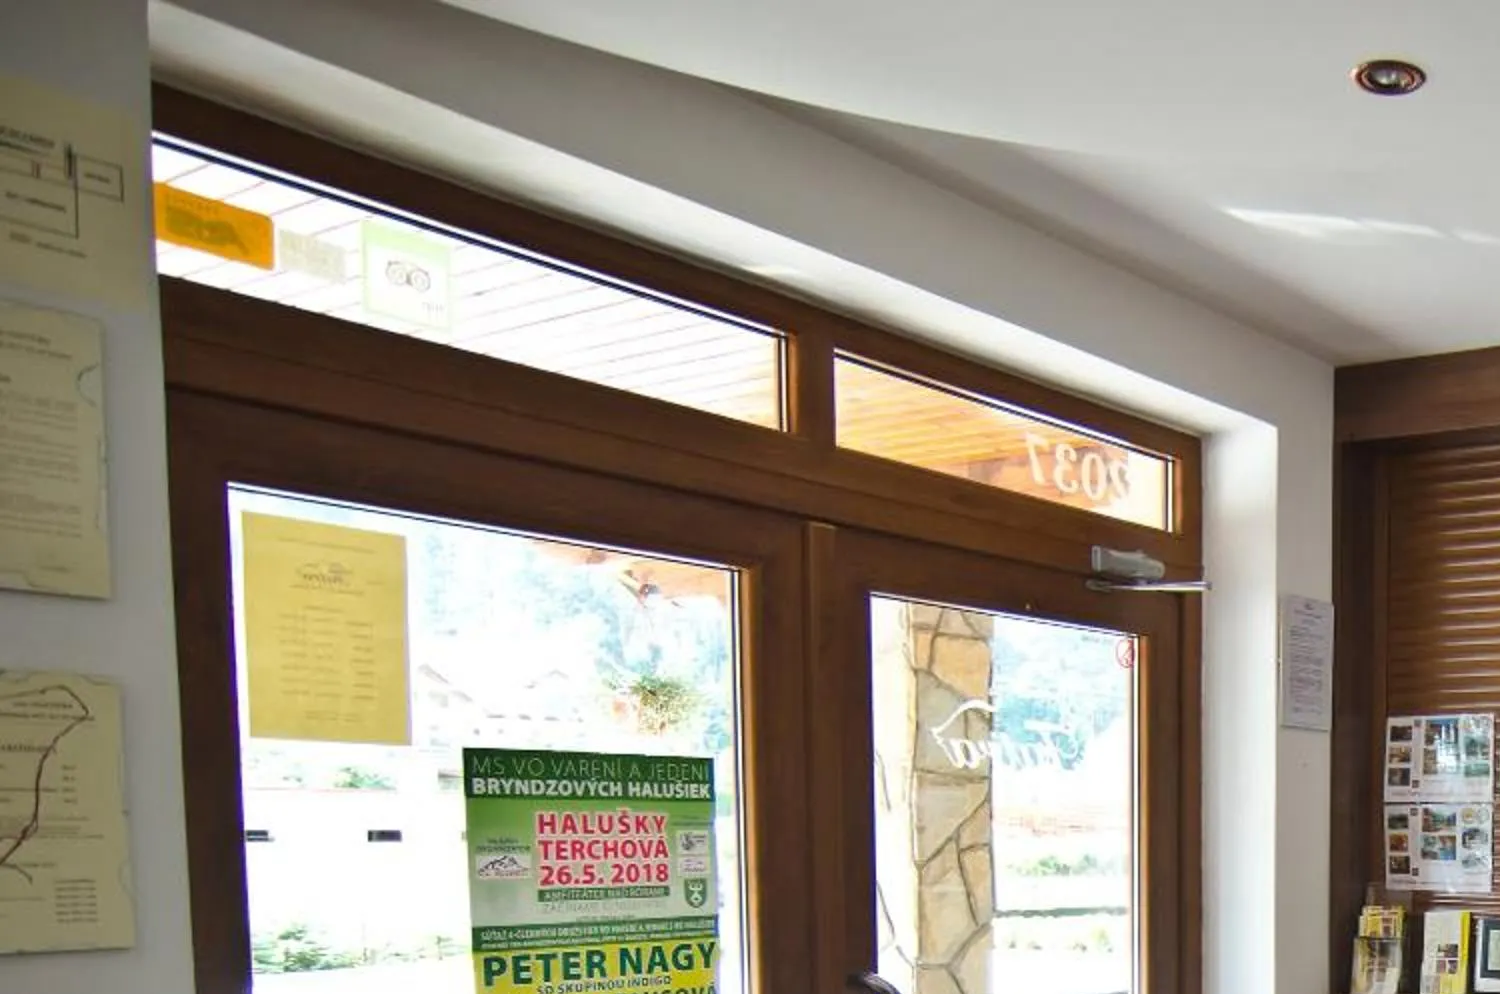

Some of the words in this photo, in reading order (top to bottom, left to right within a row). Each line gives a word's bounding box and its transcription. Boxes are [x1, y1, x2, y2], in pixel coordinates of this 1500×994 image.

[472, 755, 505, 775] MS
[511, 756, 545, 777] VO
[626, 762, 641, 778] A
[472, 777, 623, 797] BRYNDZOVÝCH
[627, 778, 710, 799] HALUŠIEK
[537, 811, 666, 835] HALUŠKY
[538, 838, 670, 861] TERCHOVÁ
[539, 865, 604, 886] 26.5.
[611, 863, 670, 883] 2018
[483, 950, 607, 987] PETER
[620, 942, 716, 976] NAGY
[558, 979, 625, 994] SKUPINOU
[627, 975, 671, 989] INDIGO
